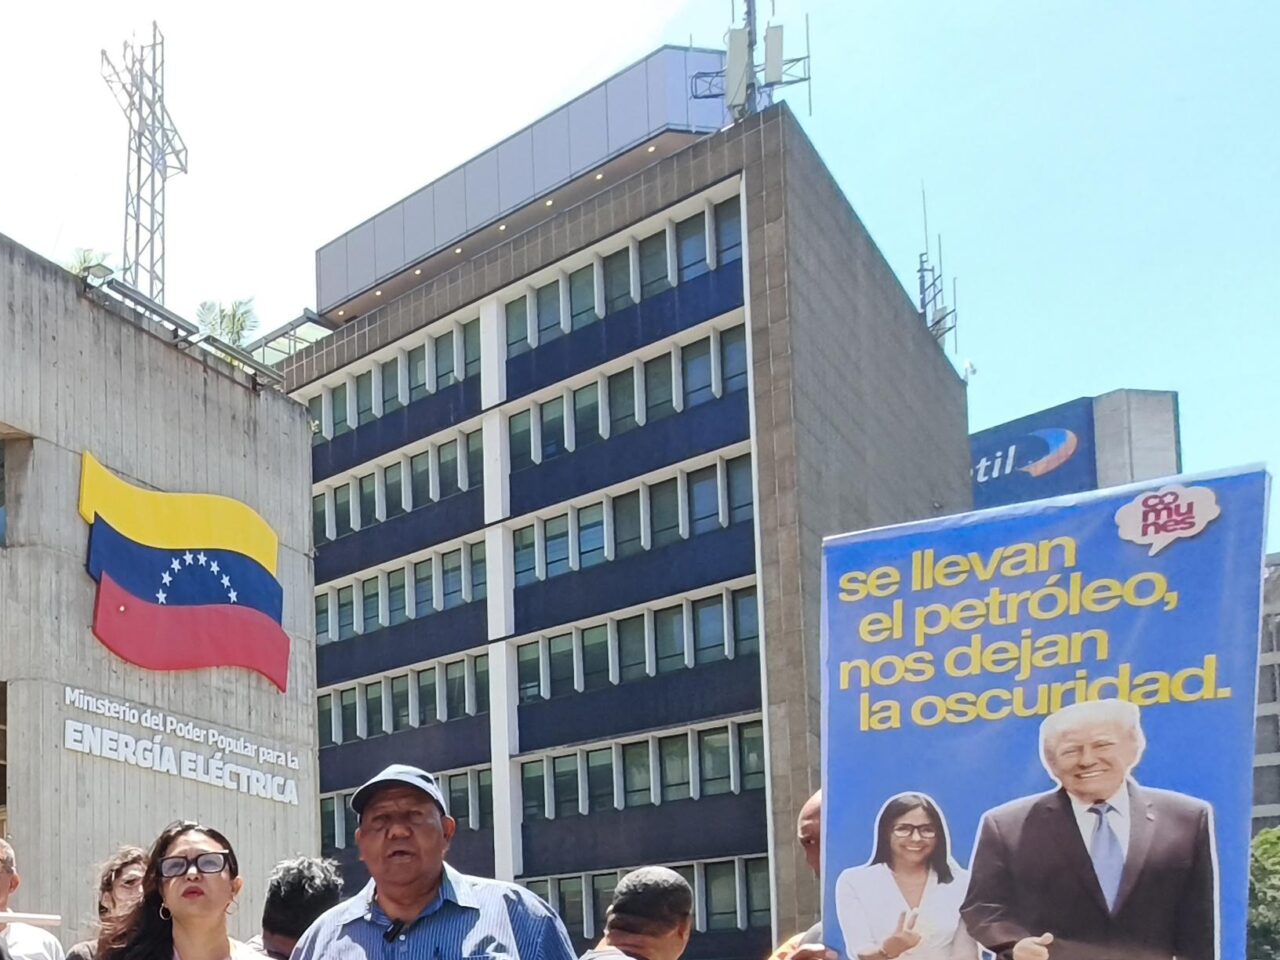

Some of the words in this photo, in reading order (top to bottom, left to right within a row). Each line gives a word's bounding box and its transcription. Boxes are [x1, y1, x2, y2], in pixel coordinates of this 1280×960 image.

[970, 445, 1016, 482] til
[838, 564, 901, 602] se
[911, 535, 1077, 591] llevan
[858, 599, 903, 643] el
[914, 570, 1178, 646] petróleo,
[839, 650, 935, 690] nos
[944, 628, 1109, 680] dejan
[859, 693, 902, 732] la
[911, 654, 1232, 726] oscuridad.
[64, 719, 178, 775] ENERGÍA
[180, 751, 298, 805] ELÉCTRICA
[65, 686, 139, 724] Ministerio
[141, 709, 164, 731] del
[166, 716, 207, 744] Poder
[208, 729, 257, 758] Popular
[259, 746, 286, 767] para
[287, 752, 299, 770] la
